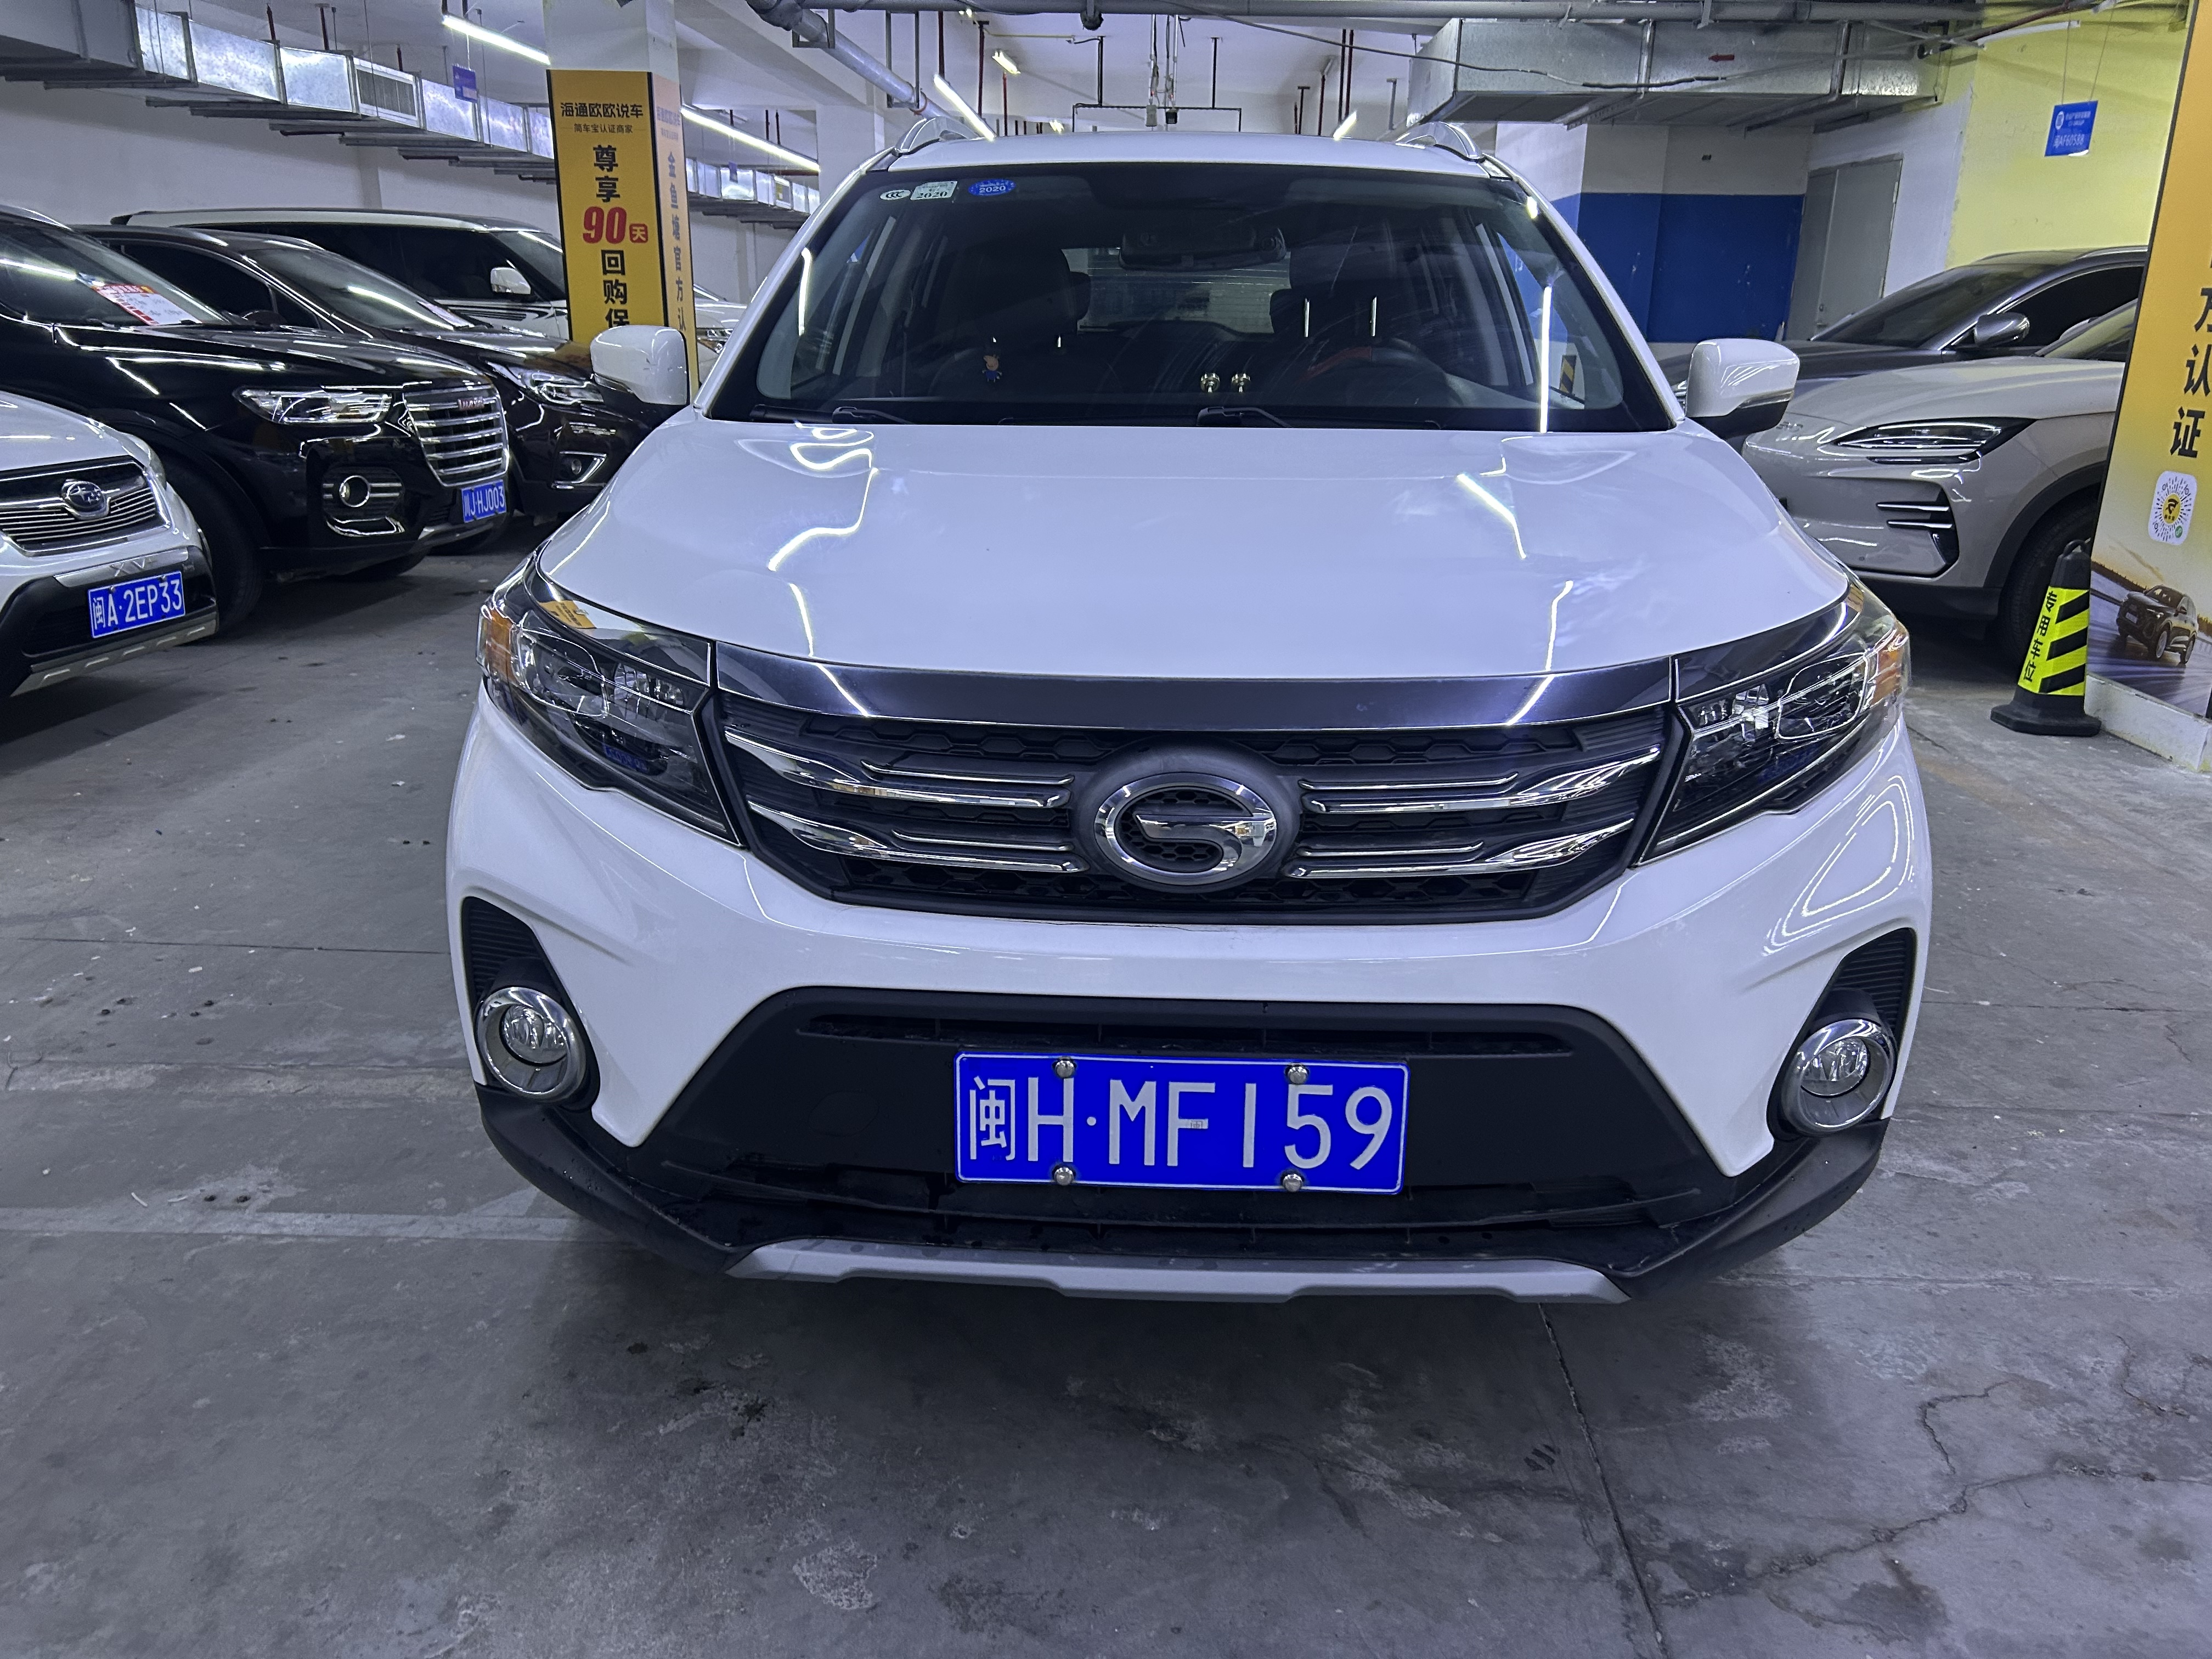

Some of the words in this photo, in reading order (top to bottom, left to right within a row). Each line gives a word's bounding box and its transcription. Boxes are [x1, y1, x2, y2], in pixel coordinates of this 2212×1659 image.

[561, 103, 644, 118] 海通欧欧说车
[2024, 590, 2057, 682] 专用车位
[969, 1075, 1392, 1170] 闽H·MF159
